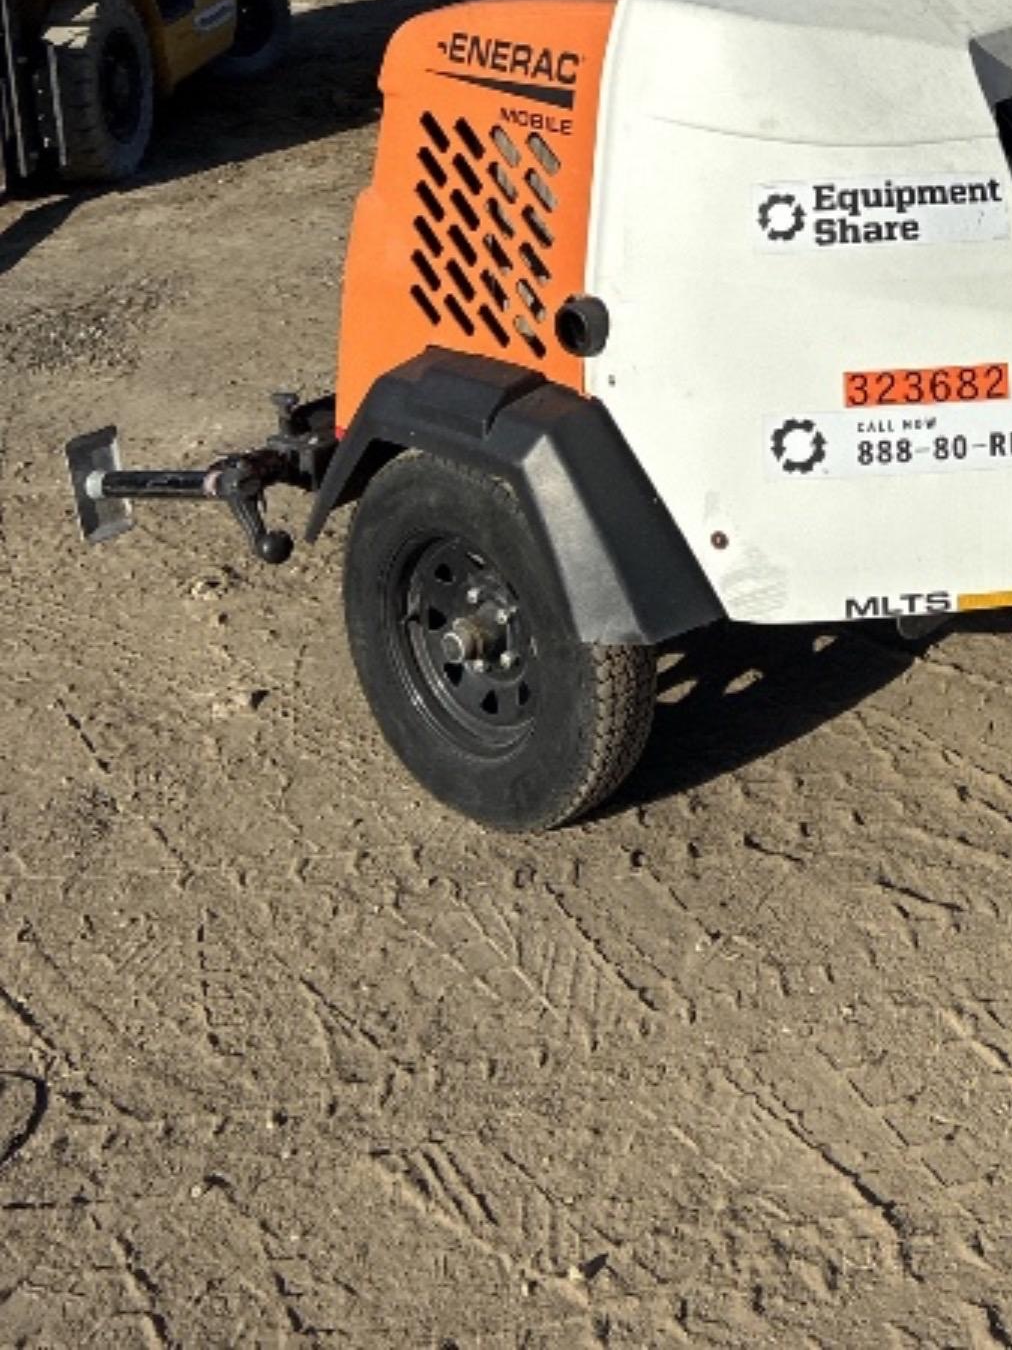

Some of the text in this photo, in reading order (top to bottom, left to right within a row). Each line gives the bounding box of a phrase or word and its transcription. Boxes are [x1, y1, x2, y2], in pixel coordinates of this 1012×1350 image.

[500, 107, 574, 136] MOBILE
[813, 179, 1003, 216] Equipment
[813, 217, 920, 247] Share
[847, 365, 1006, 406] 323682
[856, 417, 938, 433] CALL NOW
[845, 590, 952, 619] MLTS
